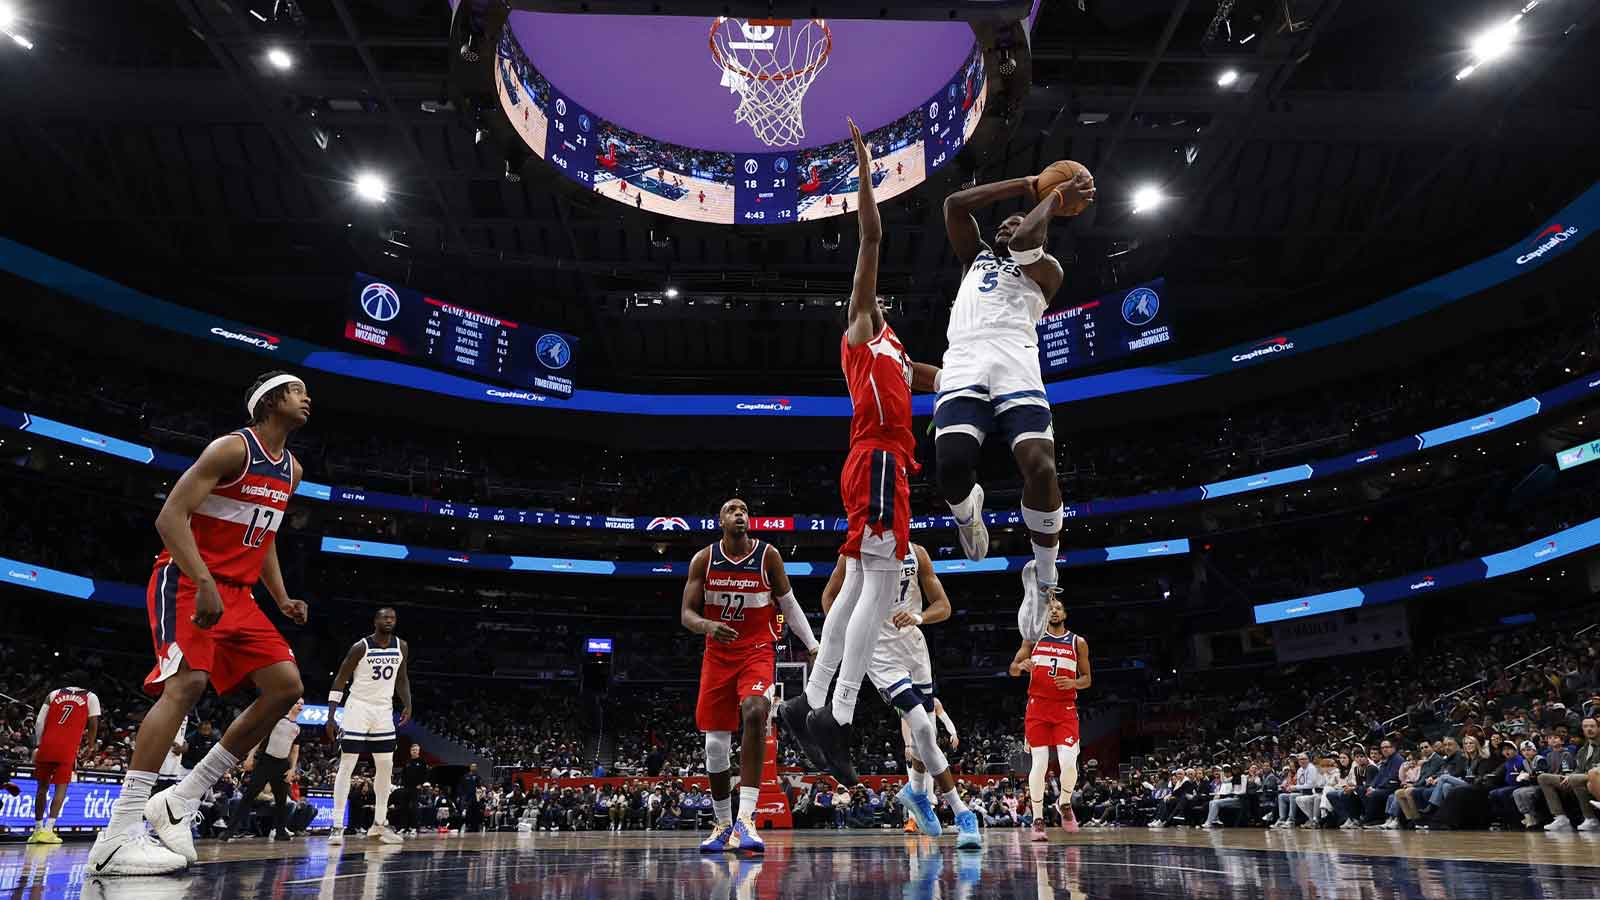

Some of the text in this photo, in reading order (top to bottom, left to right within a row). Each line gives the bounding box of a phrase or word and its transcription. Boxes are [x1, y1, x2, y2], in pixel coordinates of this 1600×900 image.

[555, 119, 564, 132] 18
[576, 134, 587, 147] 21
[552, 153, 567, 169] 4:43
[744, 179, 757, 188] 18
[773, 178, 786, 188] 21
[744, 211, 765, 219] 4:43
[777, 209, 791, 218] :12
[972, 261, 1021, 278] WOES
[978, 271, 999, 293] 5
[1048, 306, 1083, 323] MATCHUP
[354, 327, 386, 346] WIZARDS
[1127, 331, 1170, 351] TIMBERWOLVES
[534, 377, 572, 394] TIMBERWOLVES
[240, 482, 290, 503] washington
[605, 521, 635, 530] WIZARDS
[700, 519, 825, 530] 18 4:43 21
[708, 576, 760, 590] washington
[720, 593, 745, 621] 22
[367, 657, 400, 665] WOLVES
[1048, 657, 1058, 678] 3
[371, 665, 394, 681] 30
[58, 704, 74, 725] 7
